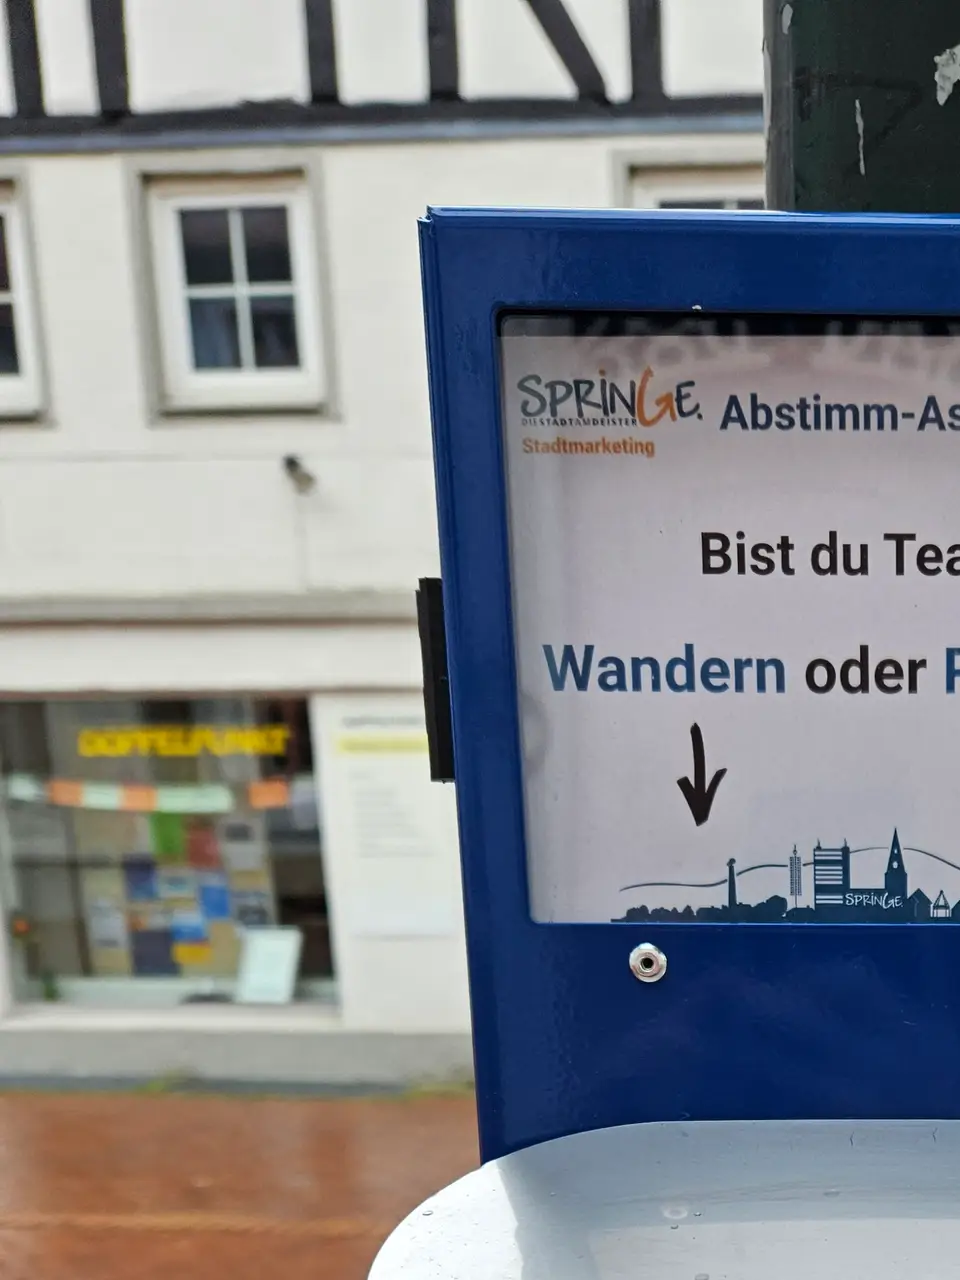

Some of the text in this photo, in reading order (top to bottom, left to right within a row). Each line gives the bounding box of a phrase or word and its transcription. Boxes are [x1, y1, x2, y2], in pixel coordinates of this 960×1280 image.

[522, 437, 656, 458] Stadtmarketing
[700, 531, 796, 576] Bist
[810, 530, 869, 577] du
[542, 643, 786, 694] Wandern
[804, 645, 928, 695] oder
